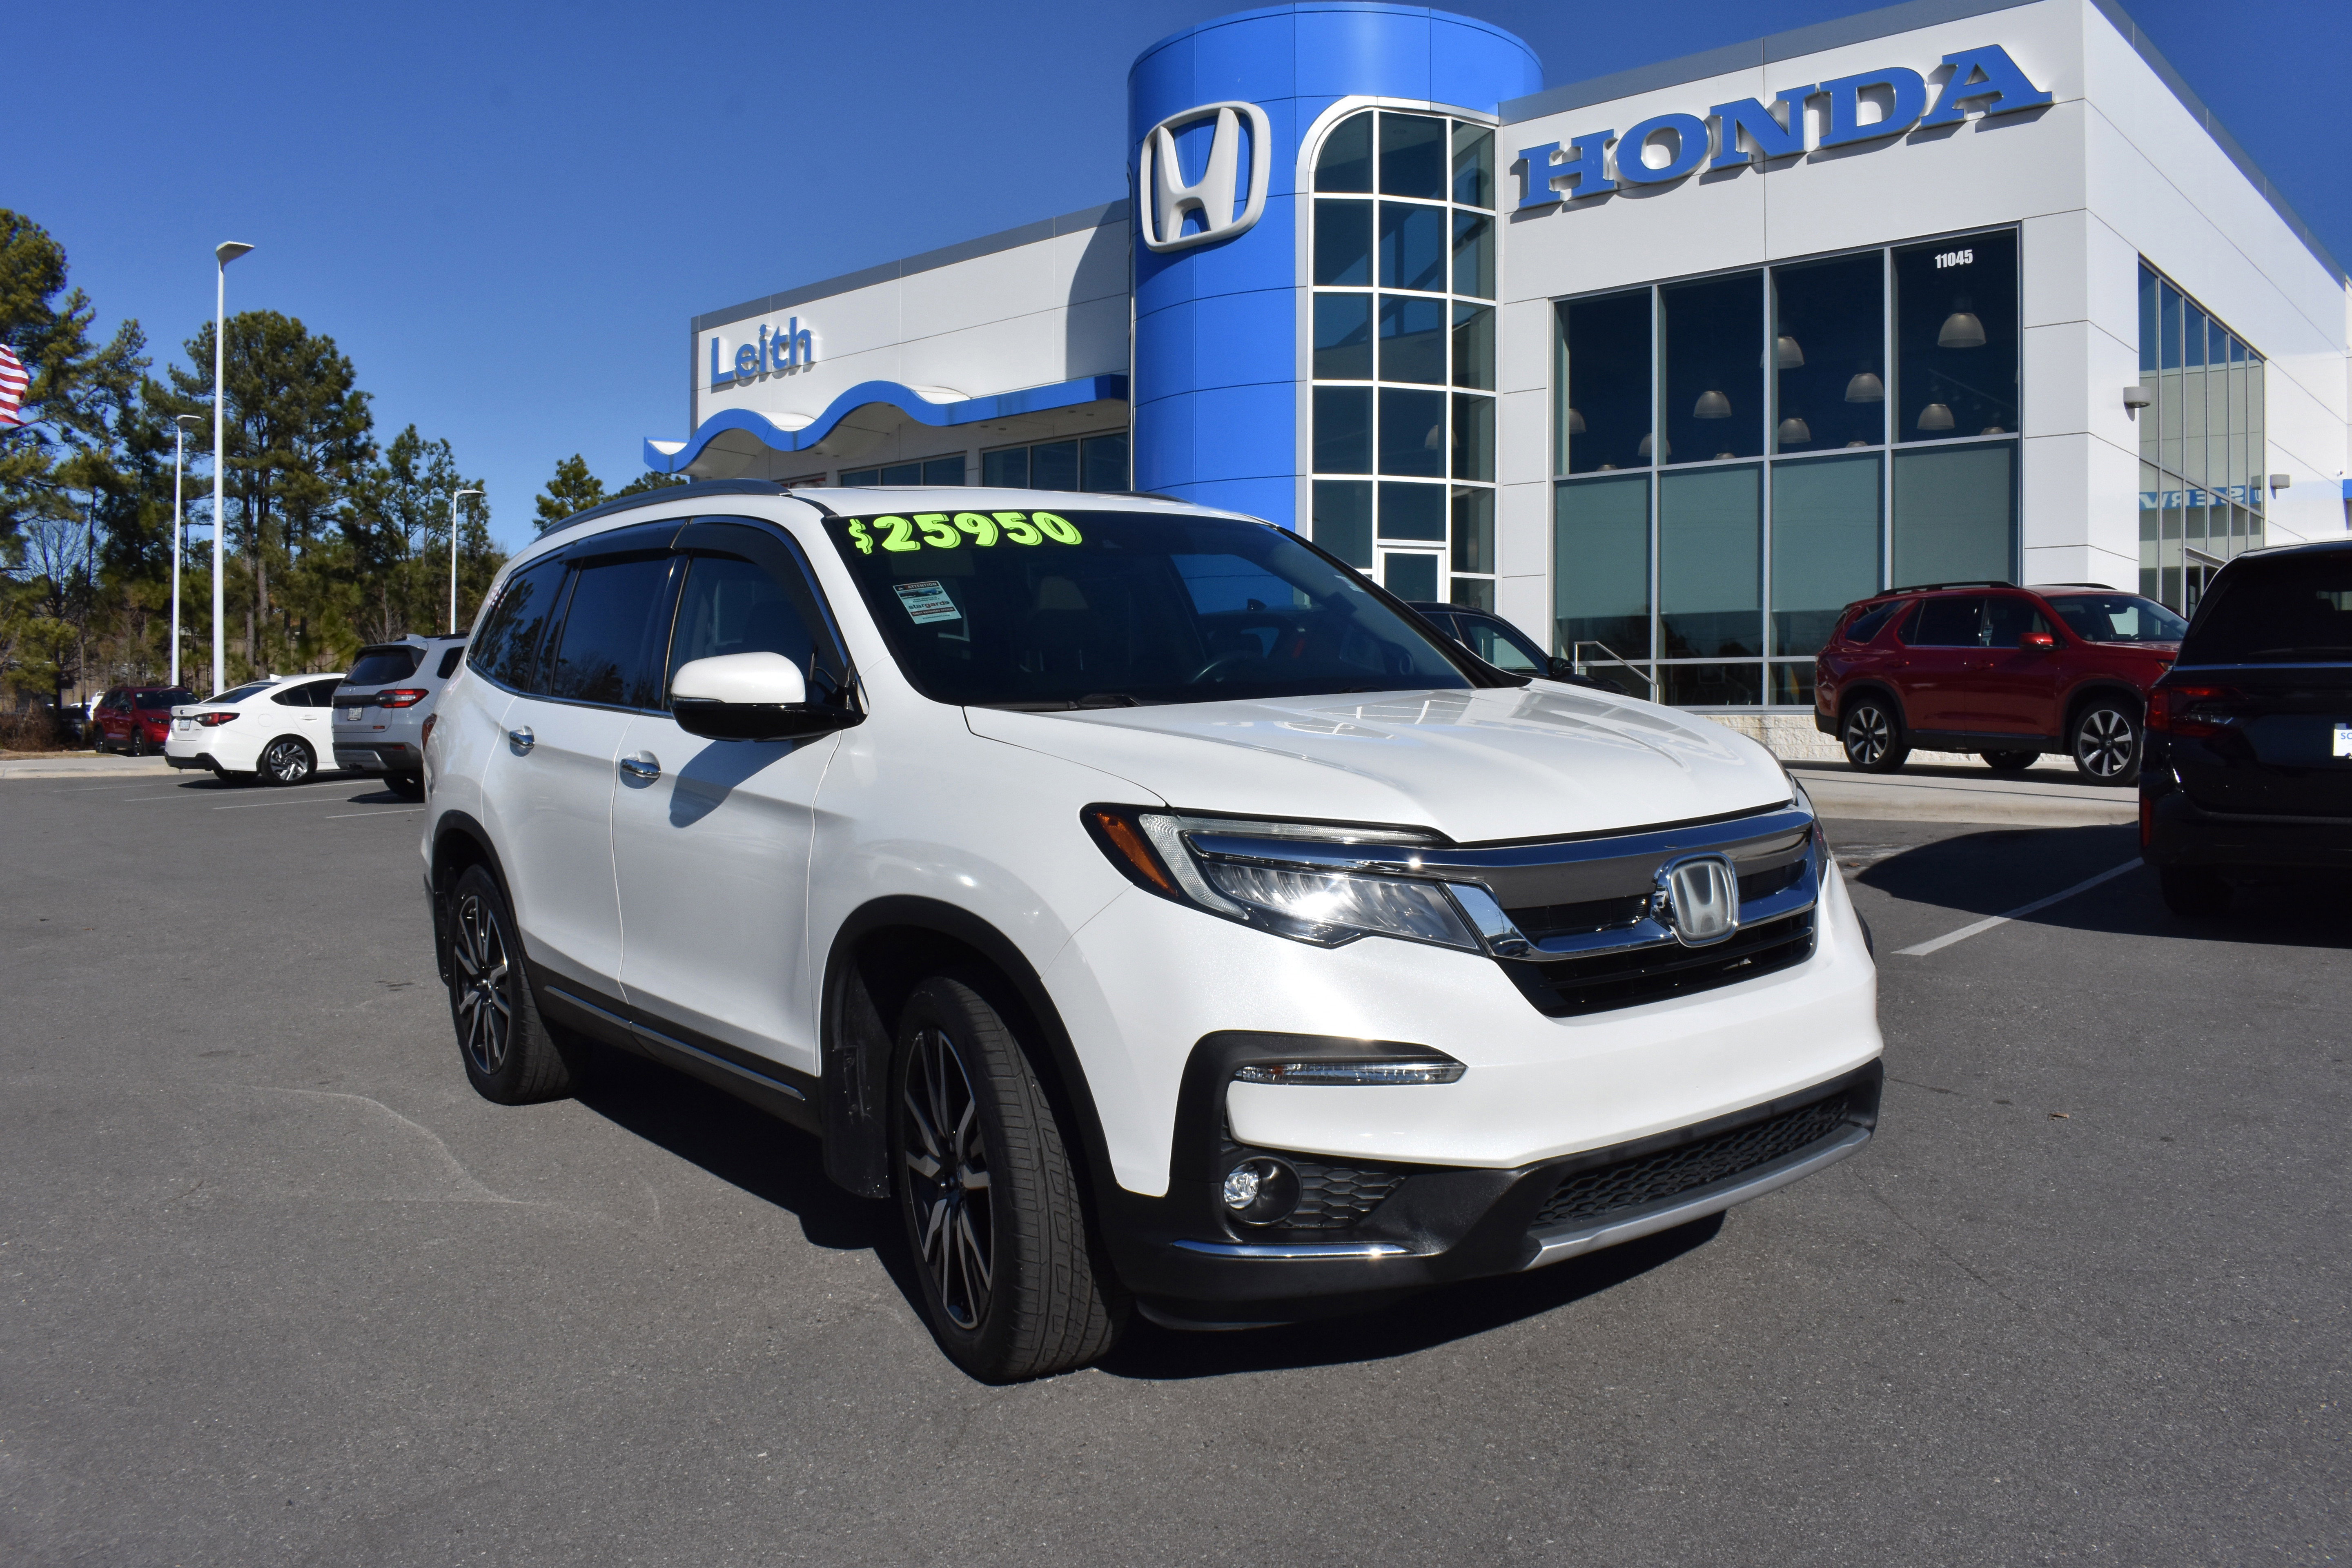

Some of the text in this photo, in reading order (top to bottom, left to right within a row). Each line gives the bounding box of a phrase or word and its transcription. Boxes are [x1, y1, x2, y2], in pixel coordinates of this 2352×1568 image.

[1518, 44, 2053, 209] HONDA
[1935, 249, 1973, 268] 11045
[711, 316, 812, 388] Leith
[849, 512, 1082, 555] $25950
[908, 601, 946, 610] stargard
